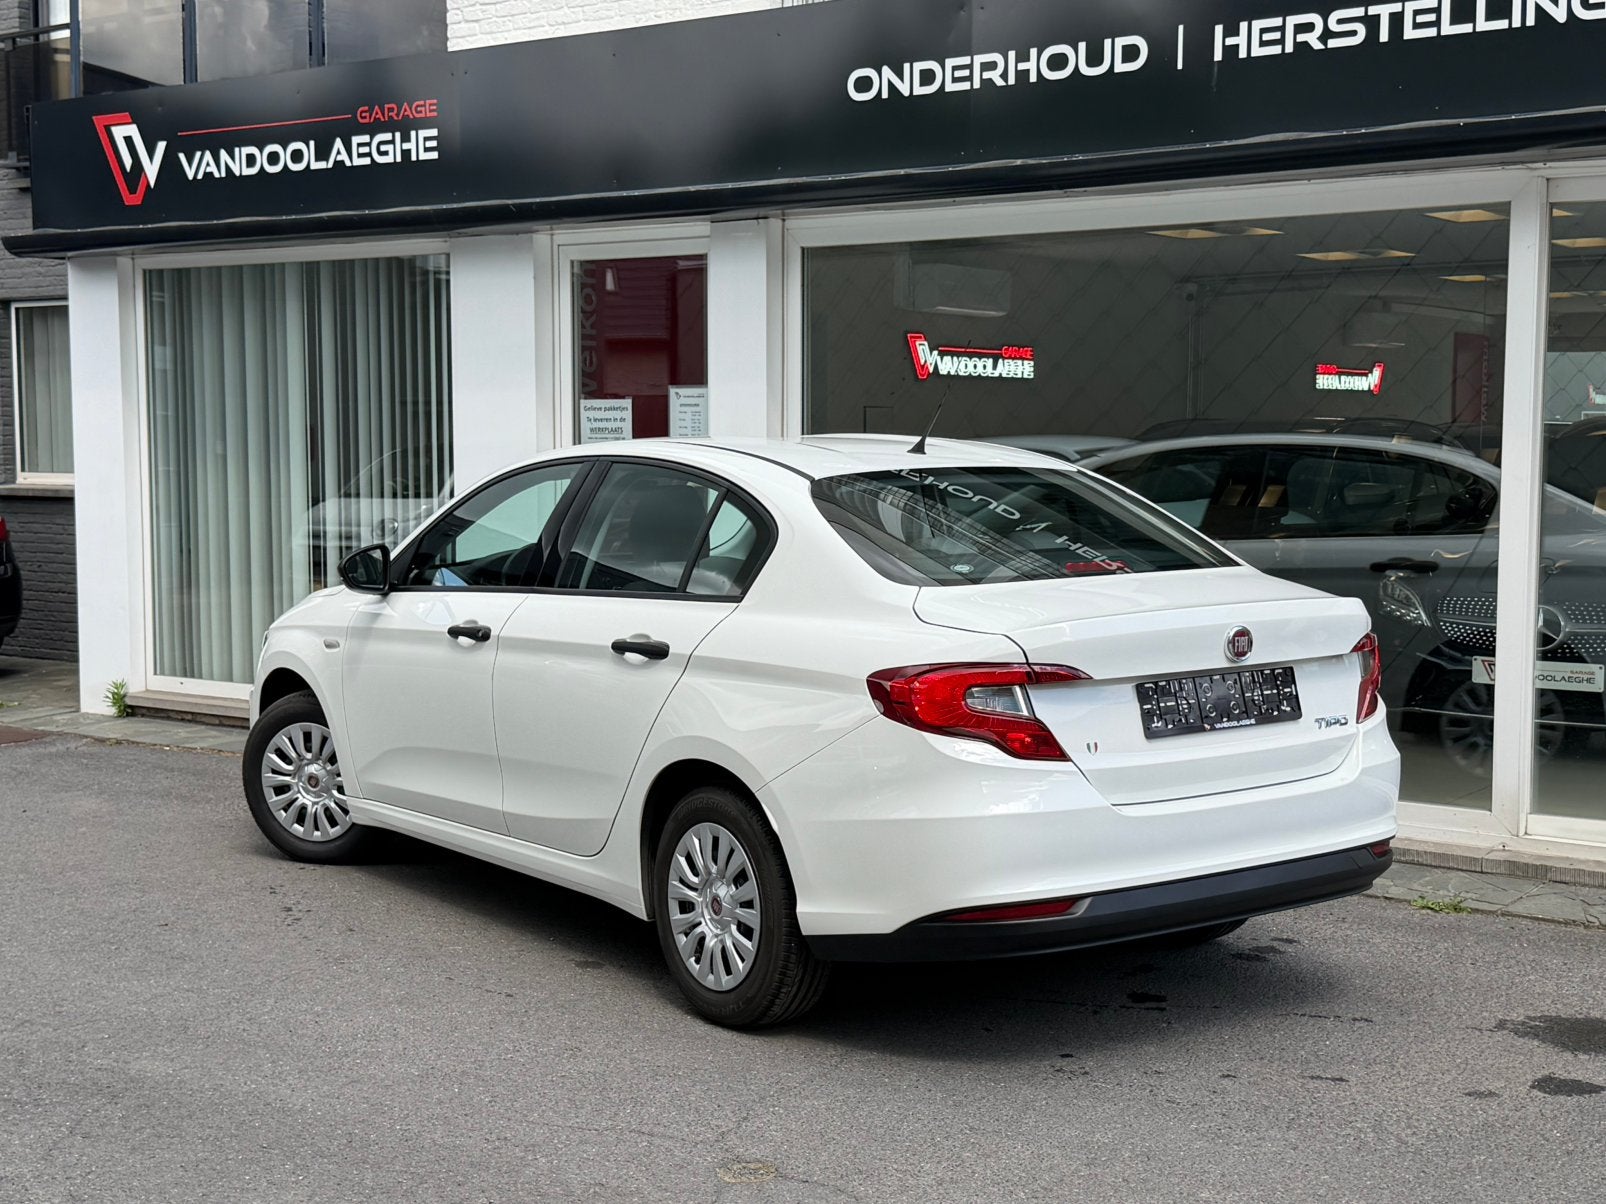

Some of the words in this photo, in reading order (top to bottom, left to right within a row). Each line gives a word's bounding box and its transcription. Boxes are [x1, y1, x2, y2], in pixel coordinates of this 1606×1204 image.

[847, 35, 1149, 102] ONDERHOUD
[357, 99, 438, 123] GARAGE
[178, 128, 439, 181] VANDOOLAEGHE
[603, 405, 628, 413] pakketjes
[1235, 636, 1249, 652] FIAT
[1536, 674, 1596, 684] OOLAEGHE
[1314, 715, 1349, 730] TIPO
